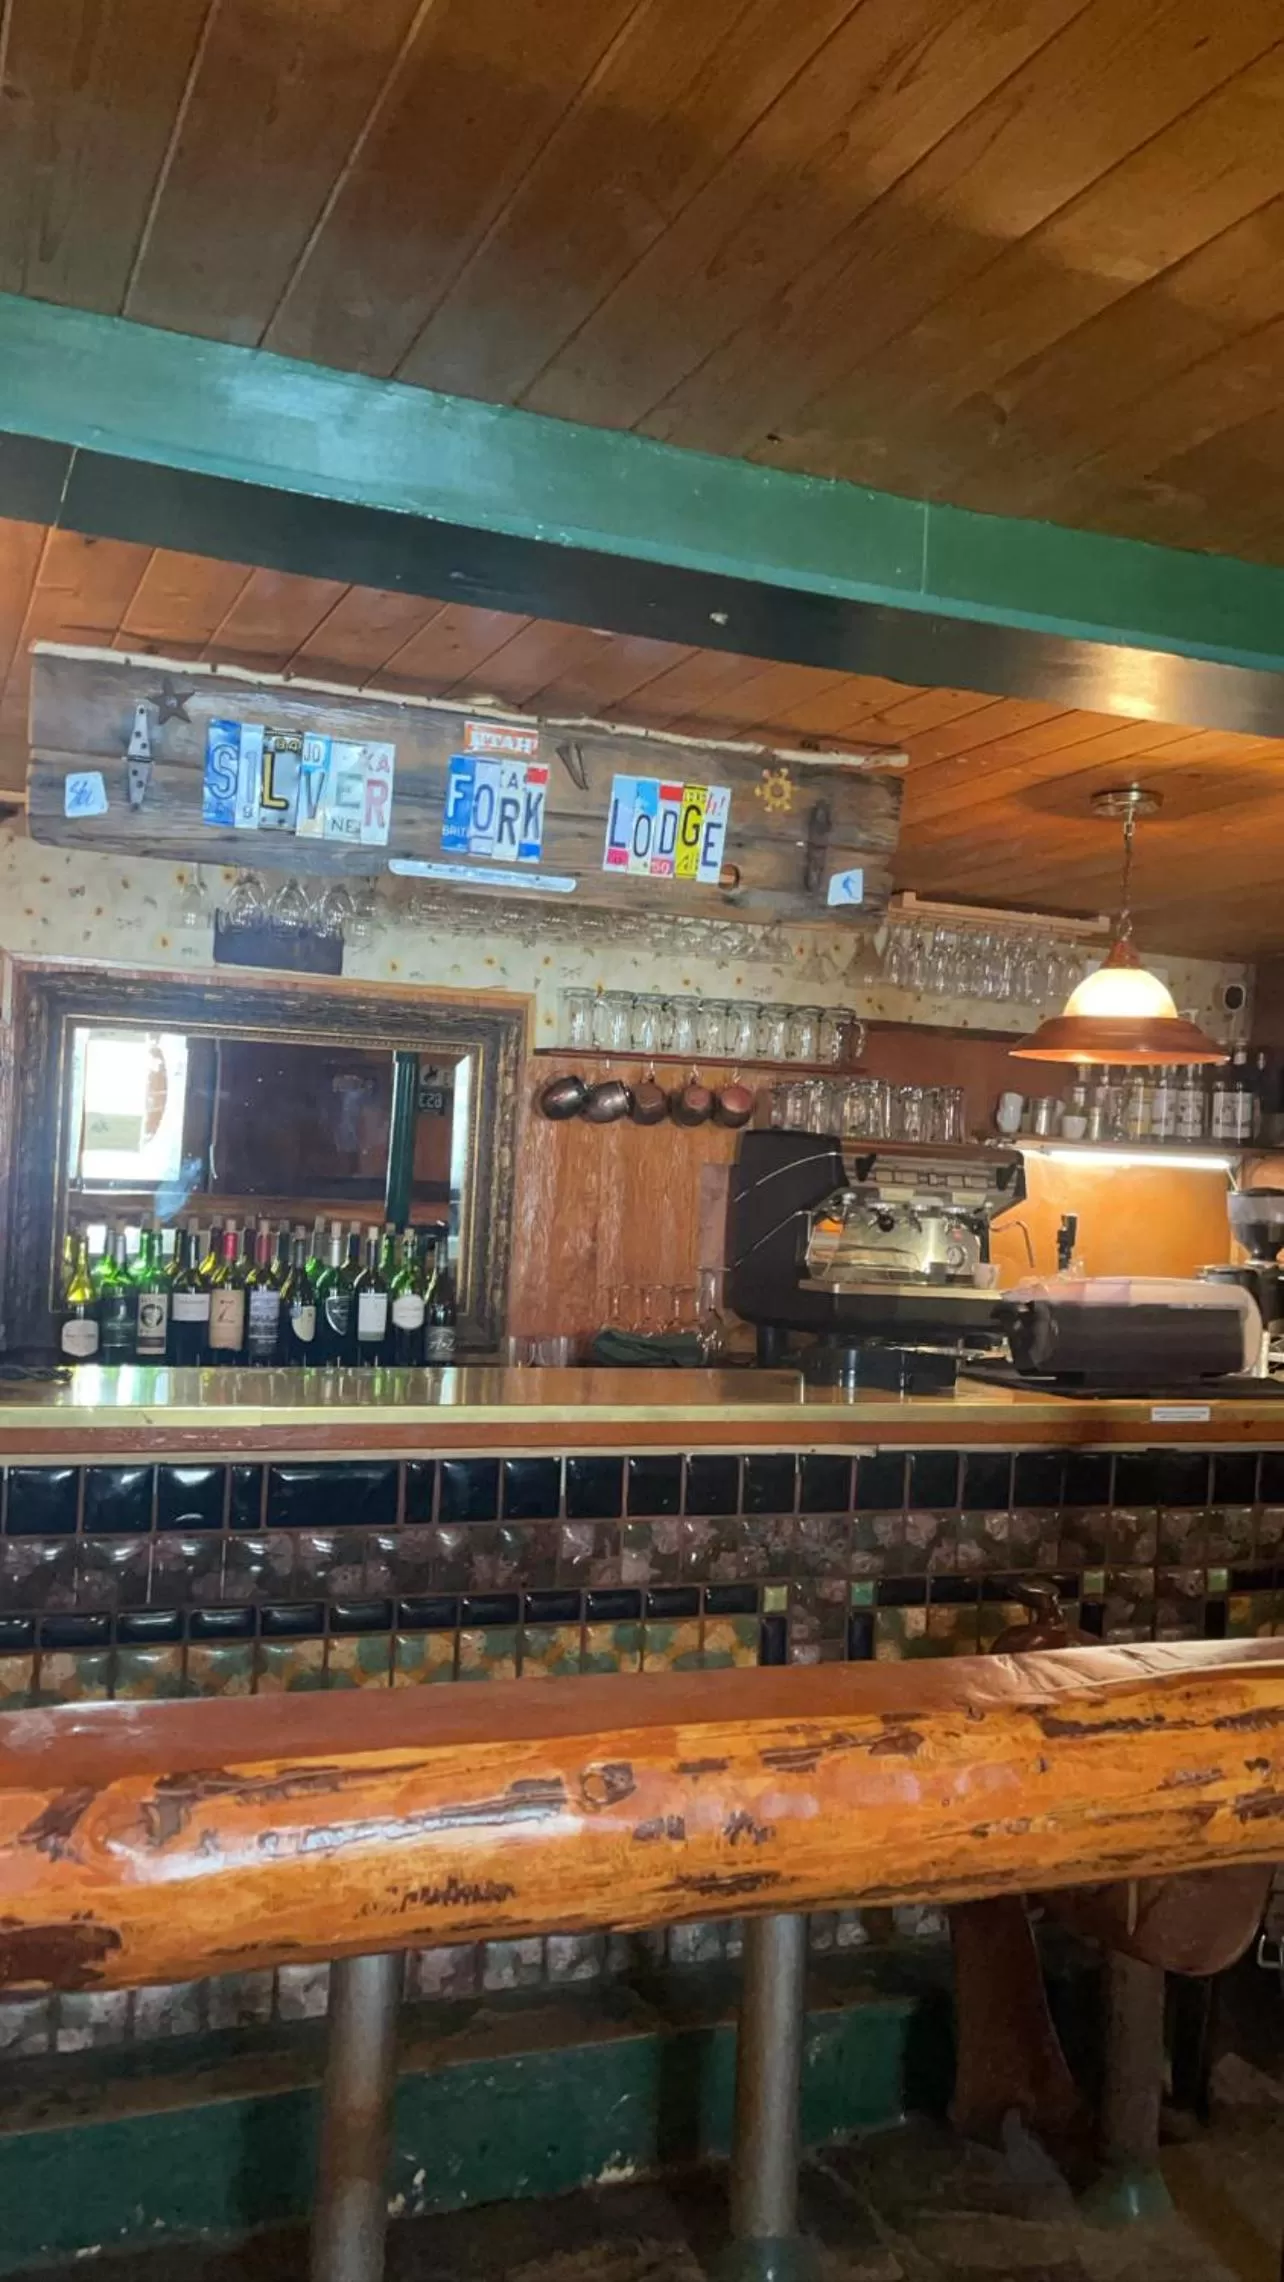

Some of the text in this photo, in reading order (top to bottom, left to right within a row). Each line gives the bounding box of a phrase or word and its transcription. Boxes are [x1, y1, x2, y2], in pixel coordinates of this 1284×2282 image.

[208, 743, 723, 868] SILVER FORK LODGE
